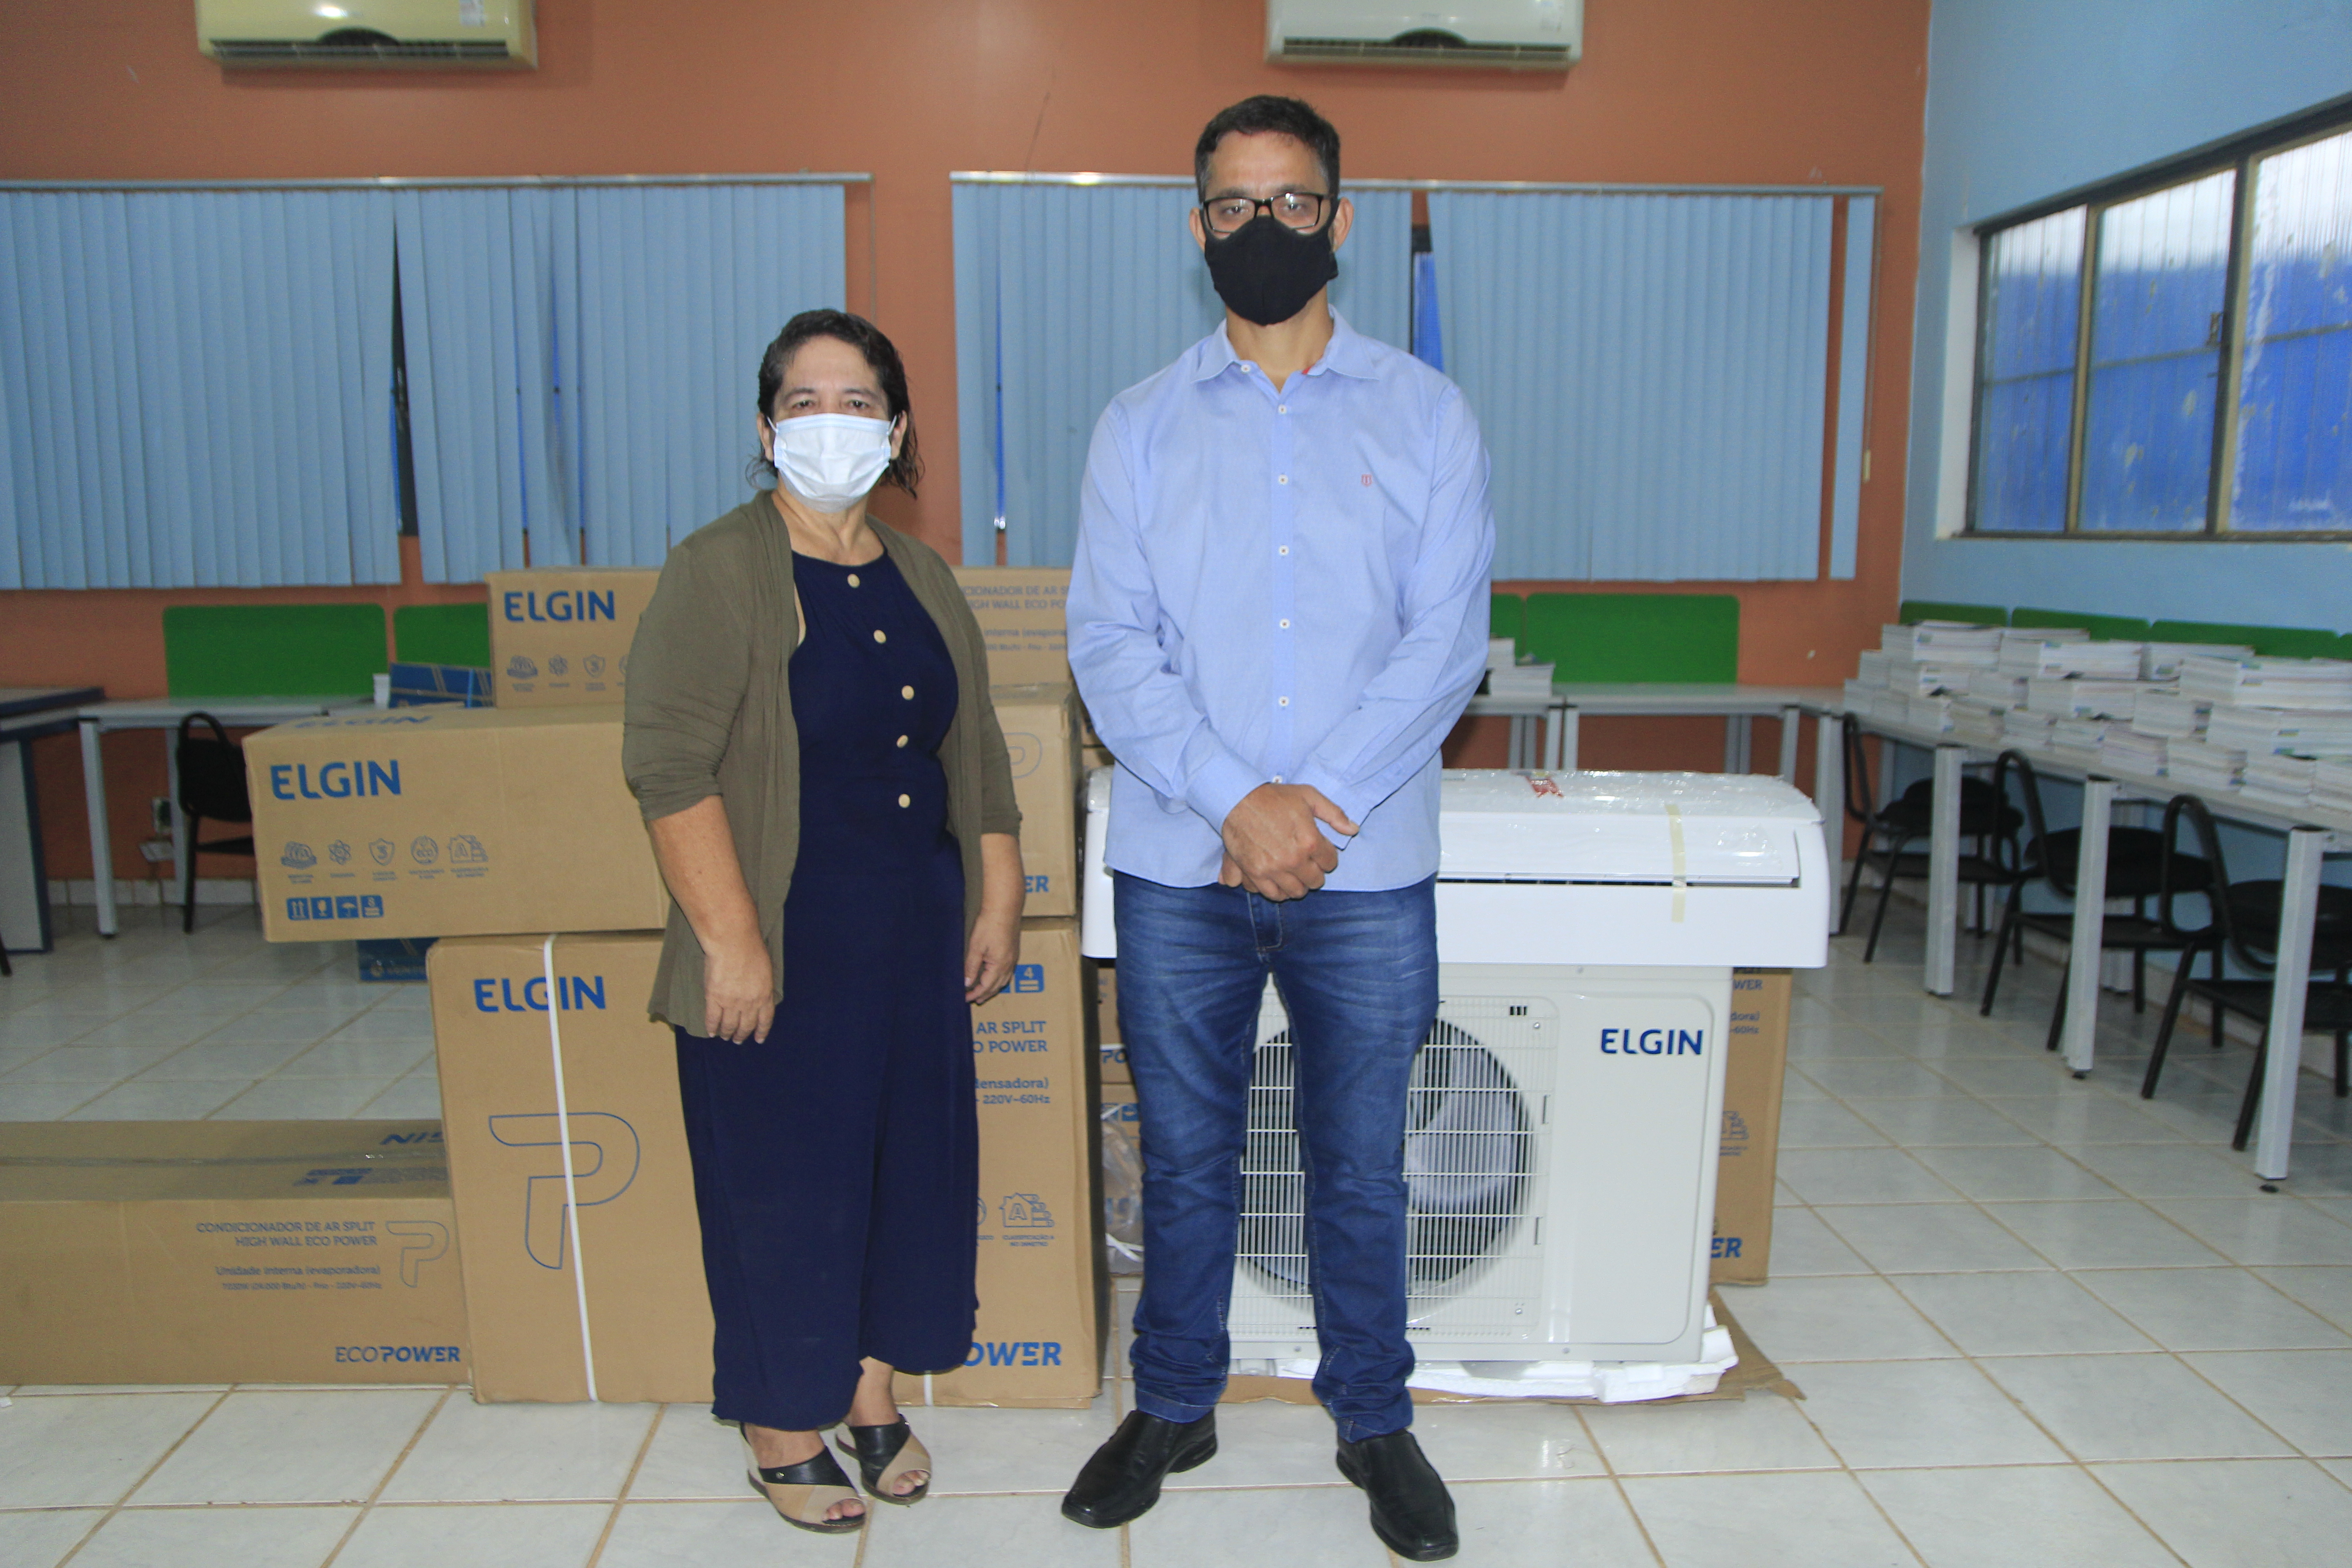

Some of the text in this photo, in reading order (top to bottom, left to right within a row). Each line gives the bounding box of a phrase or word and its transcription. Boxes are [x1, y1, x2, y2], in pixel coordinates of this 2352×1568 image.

[1026, 585, 1040, 595] DE
[1043, 585, 1058, 595] AR
[504, 590, 616, 622] ELGIN
[992, 599, 1020, 609] WALL
[1024, 599, 1048, 609] ECO
[270, 760, 401, 800] ELGIN
[474, 976, 607, 1013] ELGIN
[976, 1020, 1046, 1034] AR SPLIT
[989, 1039, 1048, 1053] POWER
[1601, 1028, 1705, 1056] ELGIN
[196, 1221, 375, 1233] CONDICIONADOR DE AR SPLIT
[235, 1235, 377, 1247] HIGH WALL ECO POWER
[335, 1346, 461, 1363] ECOPOWER
